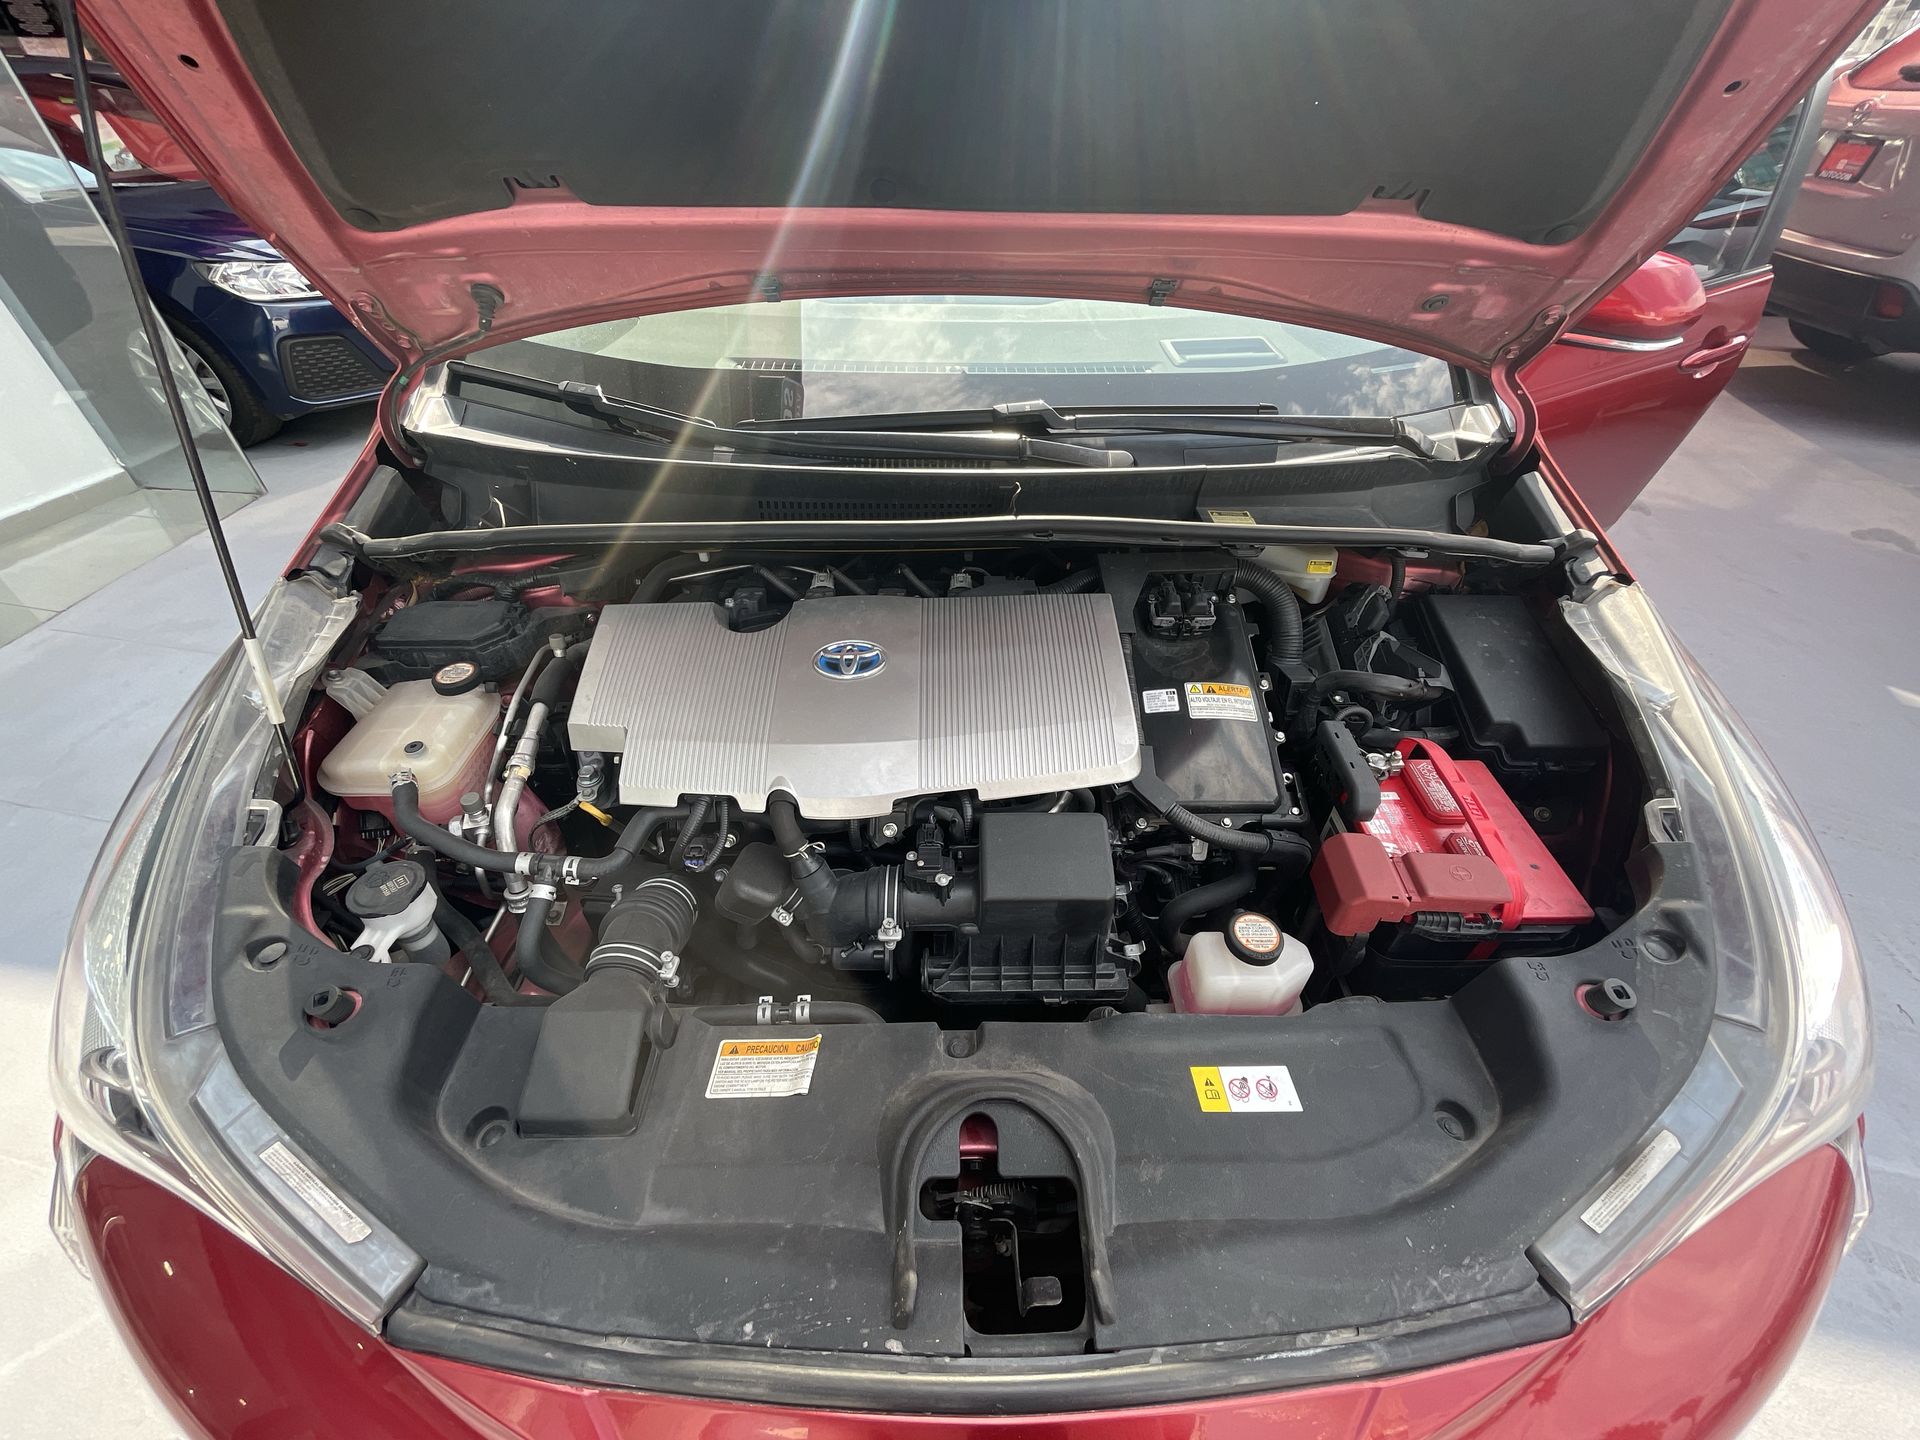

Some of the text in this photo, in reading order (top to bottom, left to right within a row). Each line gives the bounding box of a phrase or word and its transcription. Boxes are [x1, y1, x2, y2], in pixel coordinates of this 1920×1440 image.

[1218, 685, 1244, 693] ALERTA
[1202, 696, 1220, 704] VOLTAJE
[746, 1045, 789, 1054] PRECAUCIÓN
